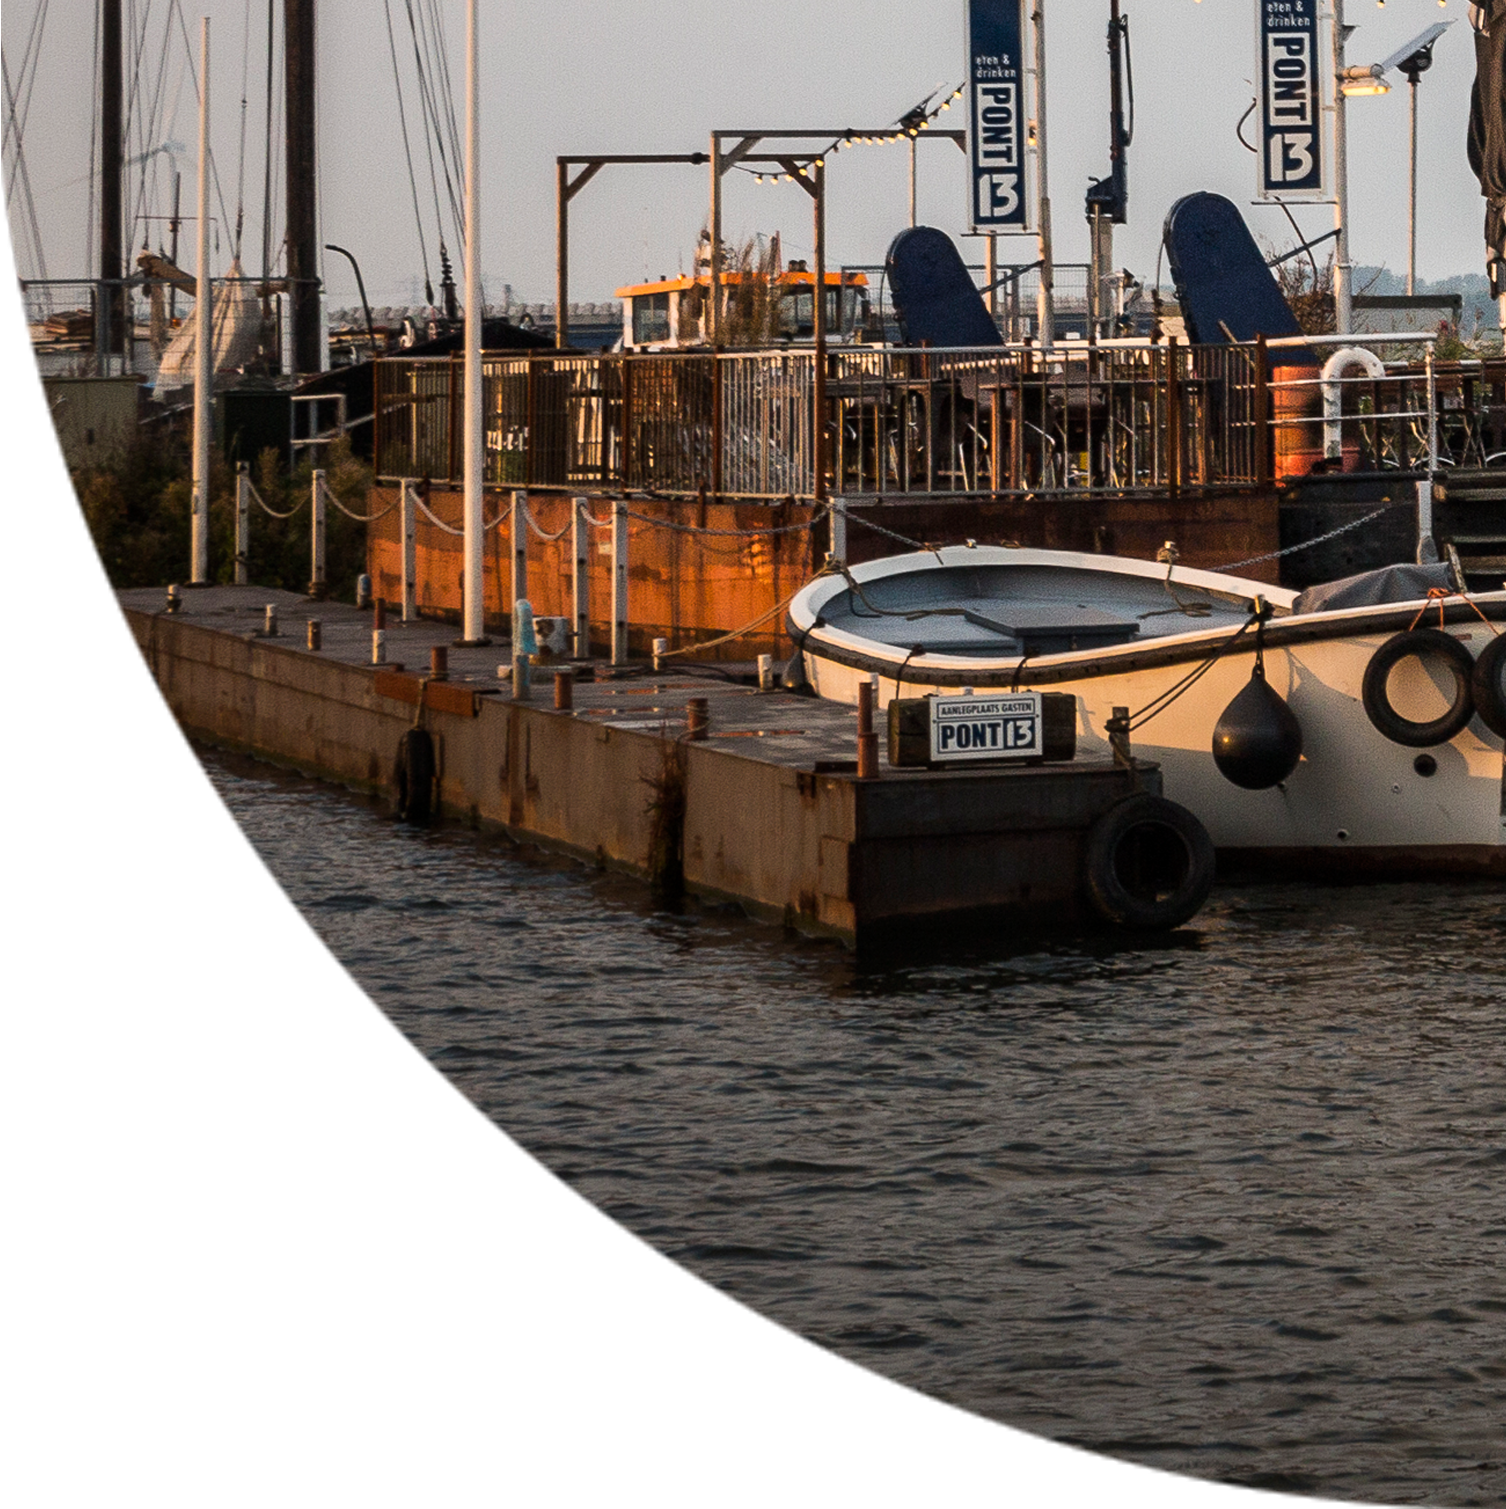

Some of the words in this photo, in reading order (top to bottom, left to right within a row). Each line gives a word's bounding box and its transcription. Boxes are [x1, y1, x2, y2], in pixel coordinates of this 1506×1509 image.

[1266, 1, 1292, 12] eten
[1295, 0, 1304, 12] &
[1267, 14, 1311, 27] drinken
[975, 55, 999, 65] eten
[1002, 54, 1010, 65] &
[976, 67, 1017, 78] drinken
[1272, 37, 1307, 121] PONT
[981, 87, 1013, 163] PONT
[1270, 133, 1313, 182] 13
[978, 173, 1019, 217] 13
[941, 704, 1000, 715] AANLEGPLAATS
[1001, 702, 1032, 712] GASTEN
[941, 722, 1001, 749] PONT
[1006, 720, 1032, 747] 13
